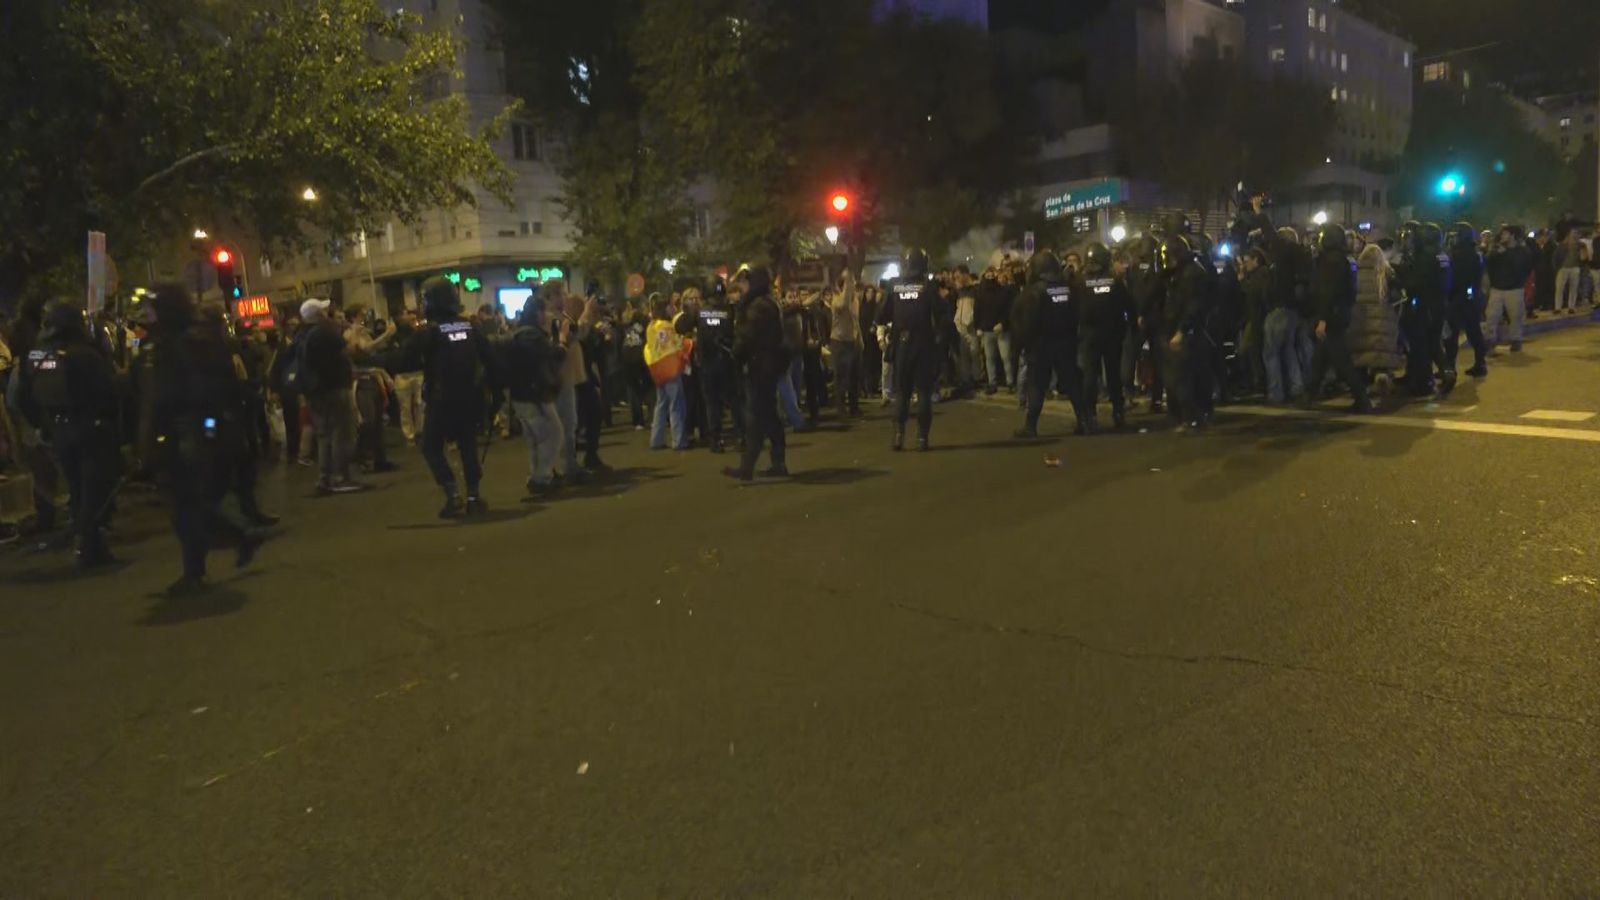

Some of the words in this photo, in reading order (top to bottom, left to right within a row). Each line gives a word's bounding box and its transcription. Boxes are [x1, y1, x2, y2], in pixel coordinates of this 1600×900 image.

[1063, 192, 1072, 203] de
[1046, 208, 1059, 218] San
[1076, 200, 1085, 211] de
[1086, 199, 1093, 209] la
[1094, 195, 1111, 207] Cruz
